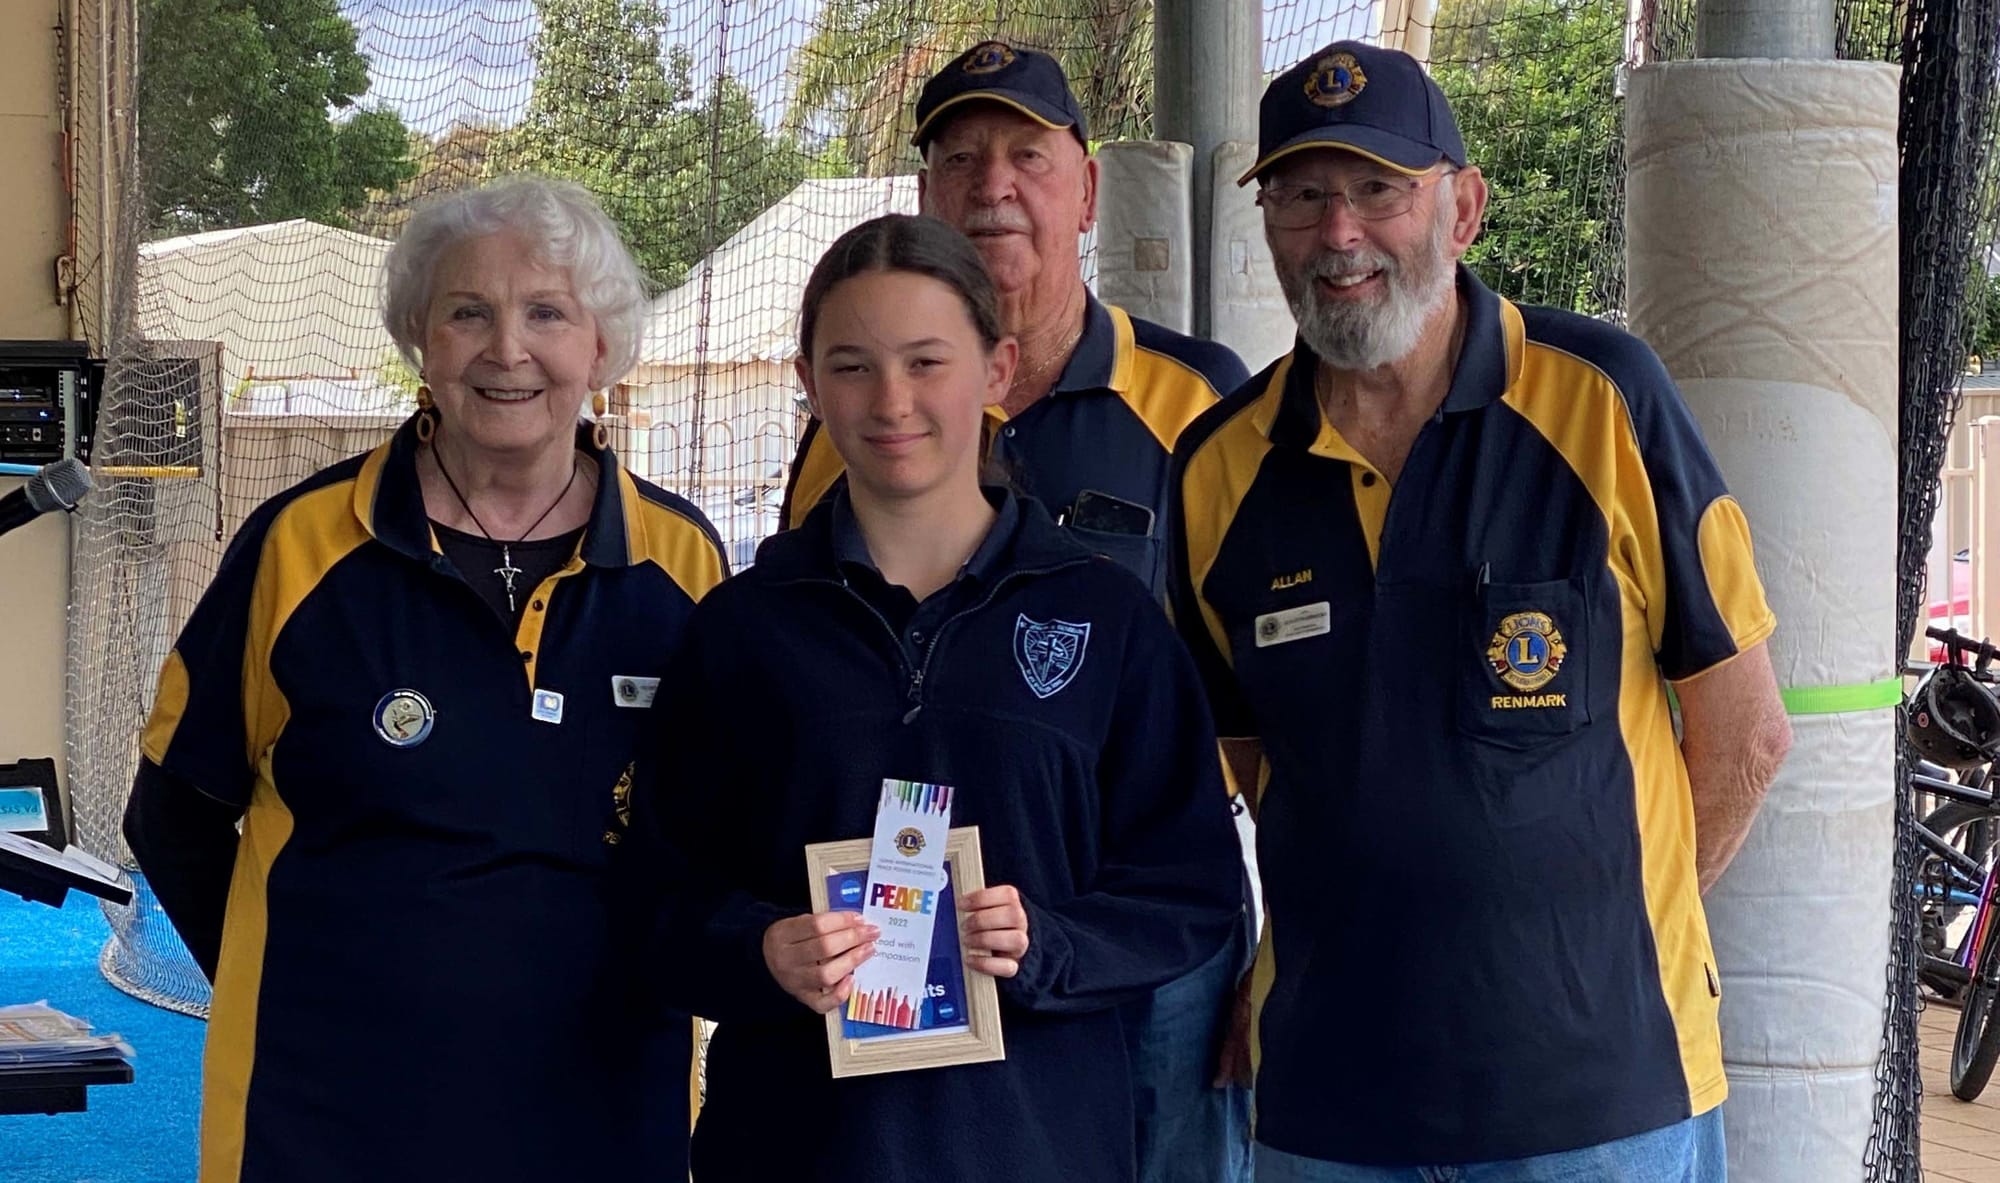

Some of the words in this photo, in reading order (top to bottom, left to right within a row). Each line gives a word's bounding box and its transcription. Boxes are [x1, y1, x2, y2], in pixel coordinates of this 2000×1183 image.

[1327, 70, 1341, 88] L
[1270, 569, 1312, 591] ALLAN
[1516, 637, 1539, 664] L
[1492, 694, 1566, 709] RENMARK
[906, 836, 915, 848] L
[870, 882, 933, 914] PEACE
[888, 917, 908, 927] 2022
[897, 941, 915, 949] with
[873, 951, 921, 963] ompassion
